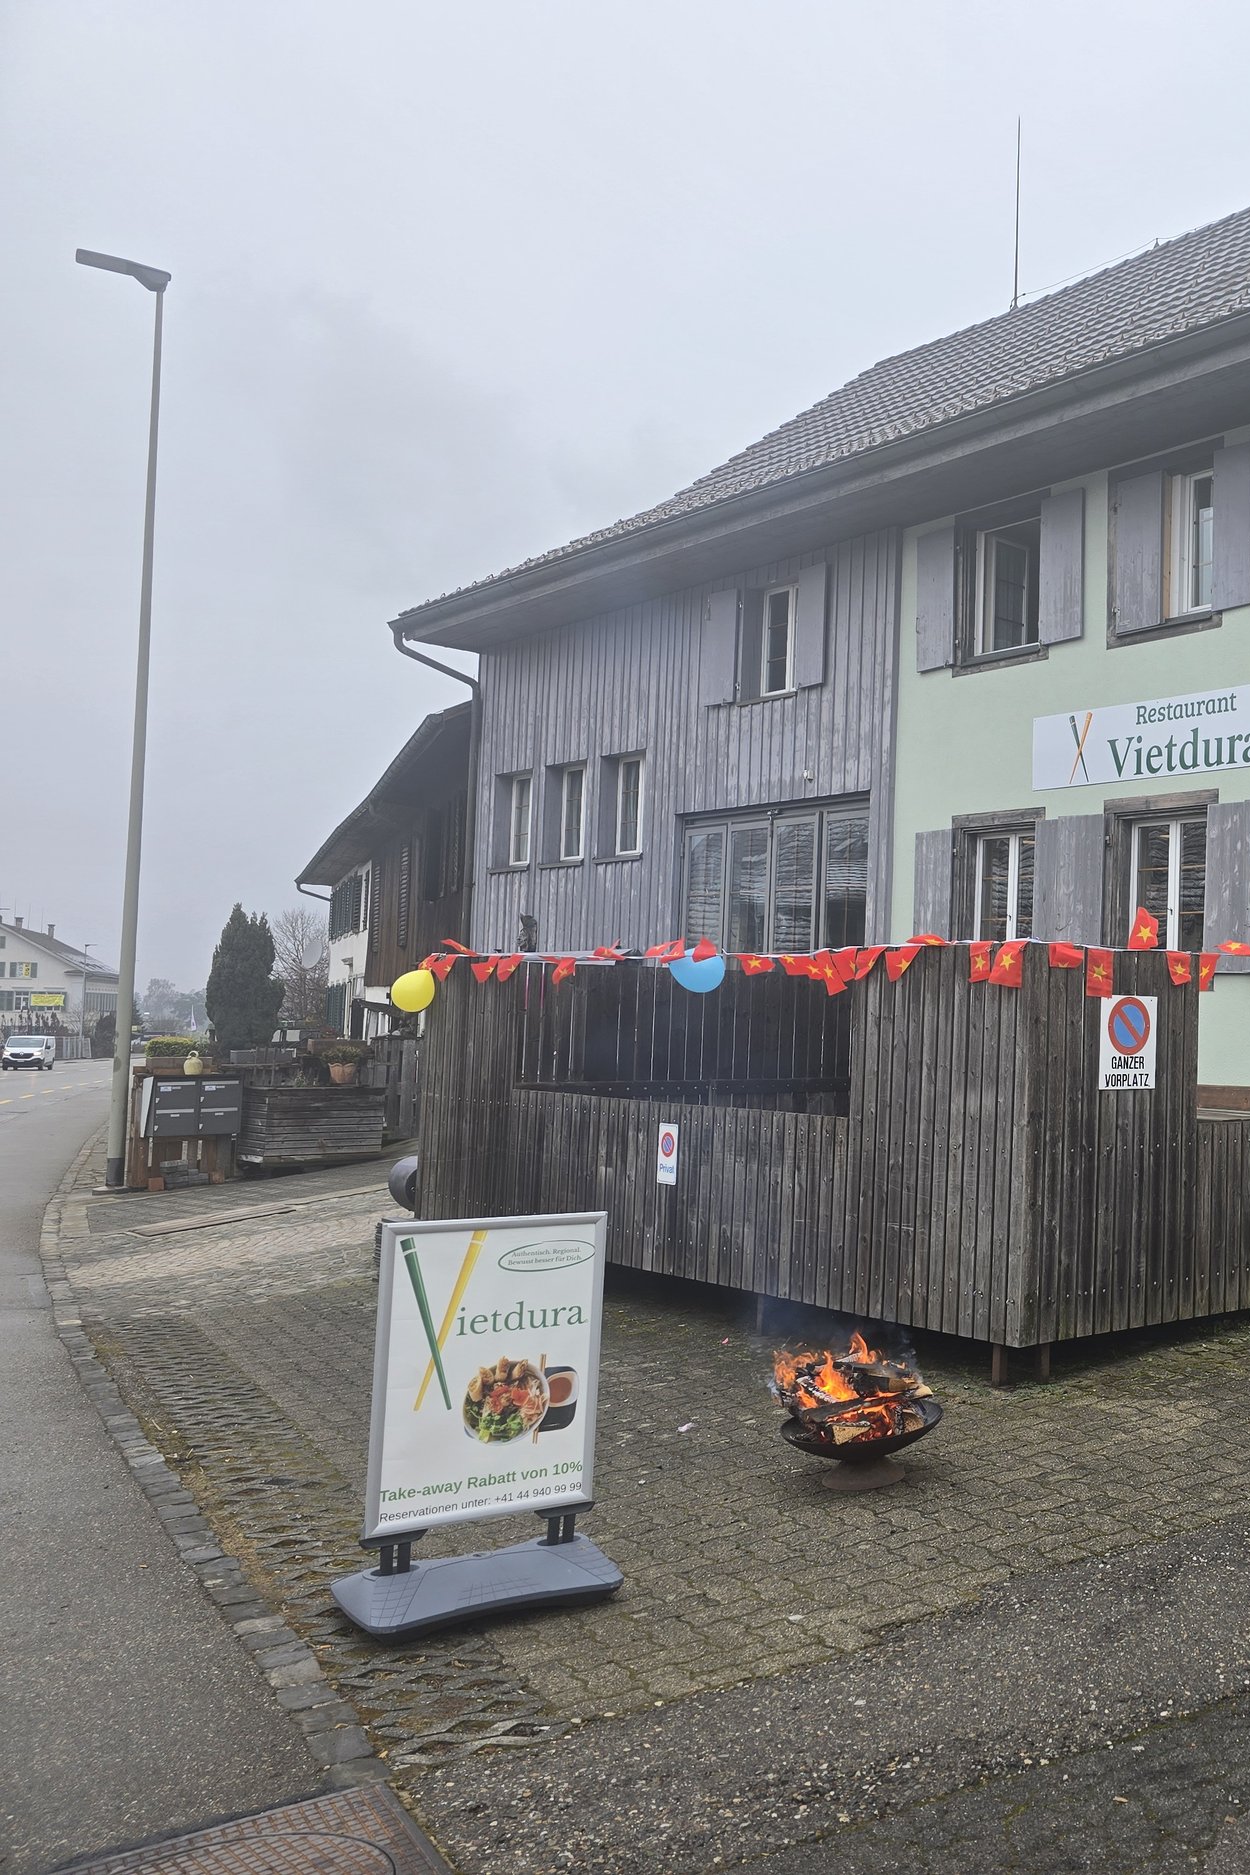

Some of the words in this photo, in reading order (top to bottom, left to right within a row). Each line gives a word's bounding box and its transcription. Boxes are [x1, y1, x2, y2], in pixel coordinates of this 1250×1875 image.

[1135, 692, 1238, 725] Restaurant
[1111, 1056, 1145, 1070] GANZER
[1105, 1073, 1150, 1088] VORPLATZ
[659, 1163, 675, 1174] Privat
[380, 1480, 463, 1503] Take-away
[467, 1471, 516, 1490] Rabatt
[521, 1466, 548, 1481] von
[552, 1460, 583, 1476] 10%
[379, 1501, 458, 1523] Reservationen
[461, 1497, 491, 1510] unter:
[494, 1493, 513, 1504] +41
[516, 1490, 530, 1501] 44
[532, 1487, 551, 1498] 940
[554, 1484, 567, 1494] 99
[569, 1481, 582, 1492] 99
